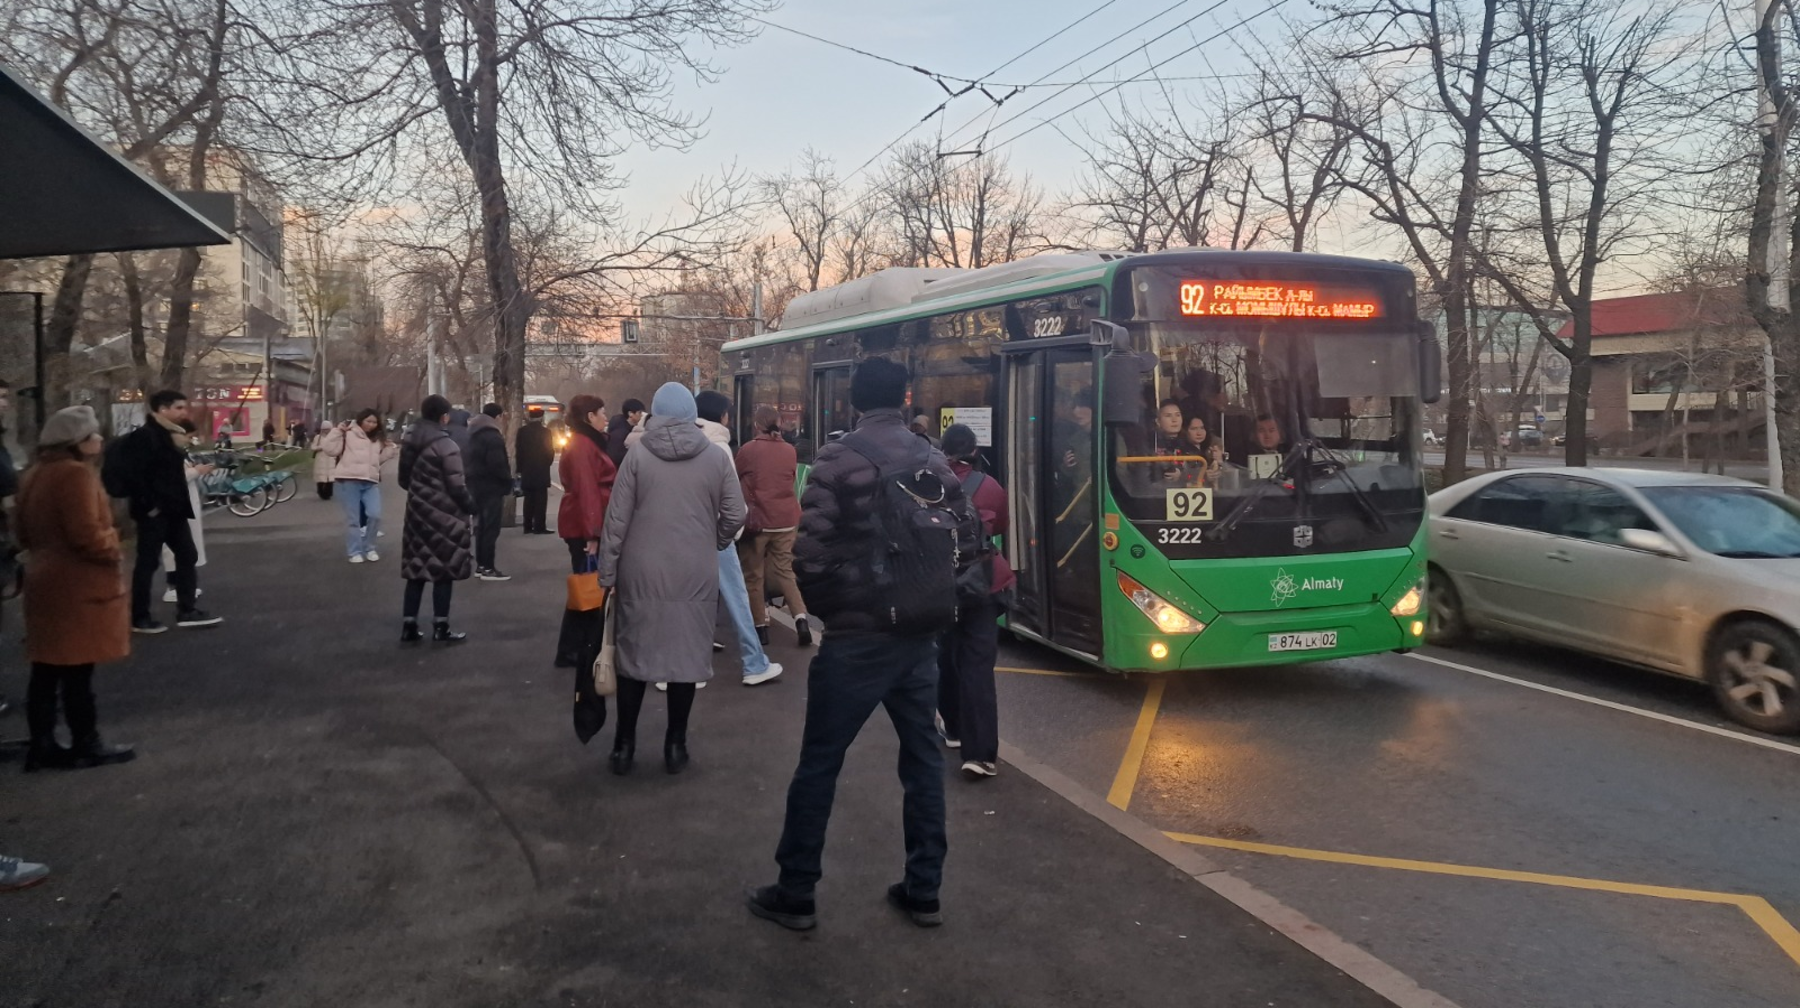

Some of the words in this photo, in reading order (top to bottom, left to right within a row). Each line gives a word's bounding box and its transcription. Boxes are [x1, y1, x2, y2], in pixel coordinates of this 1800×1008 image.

[1180, 284, 1205, 314] 92
[1033, 316, 1062, 338] 3222
[1173, 491, 1208, 517] 92
[1158, 528, 1202, 544] 3222
[1301, 576, 1344, 591] Almaty
[1280, 635, 1302, 648] 874
[1305, 637, 1318, 648] LK
[1322, 633, 1336, 646] 02
